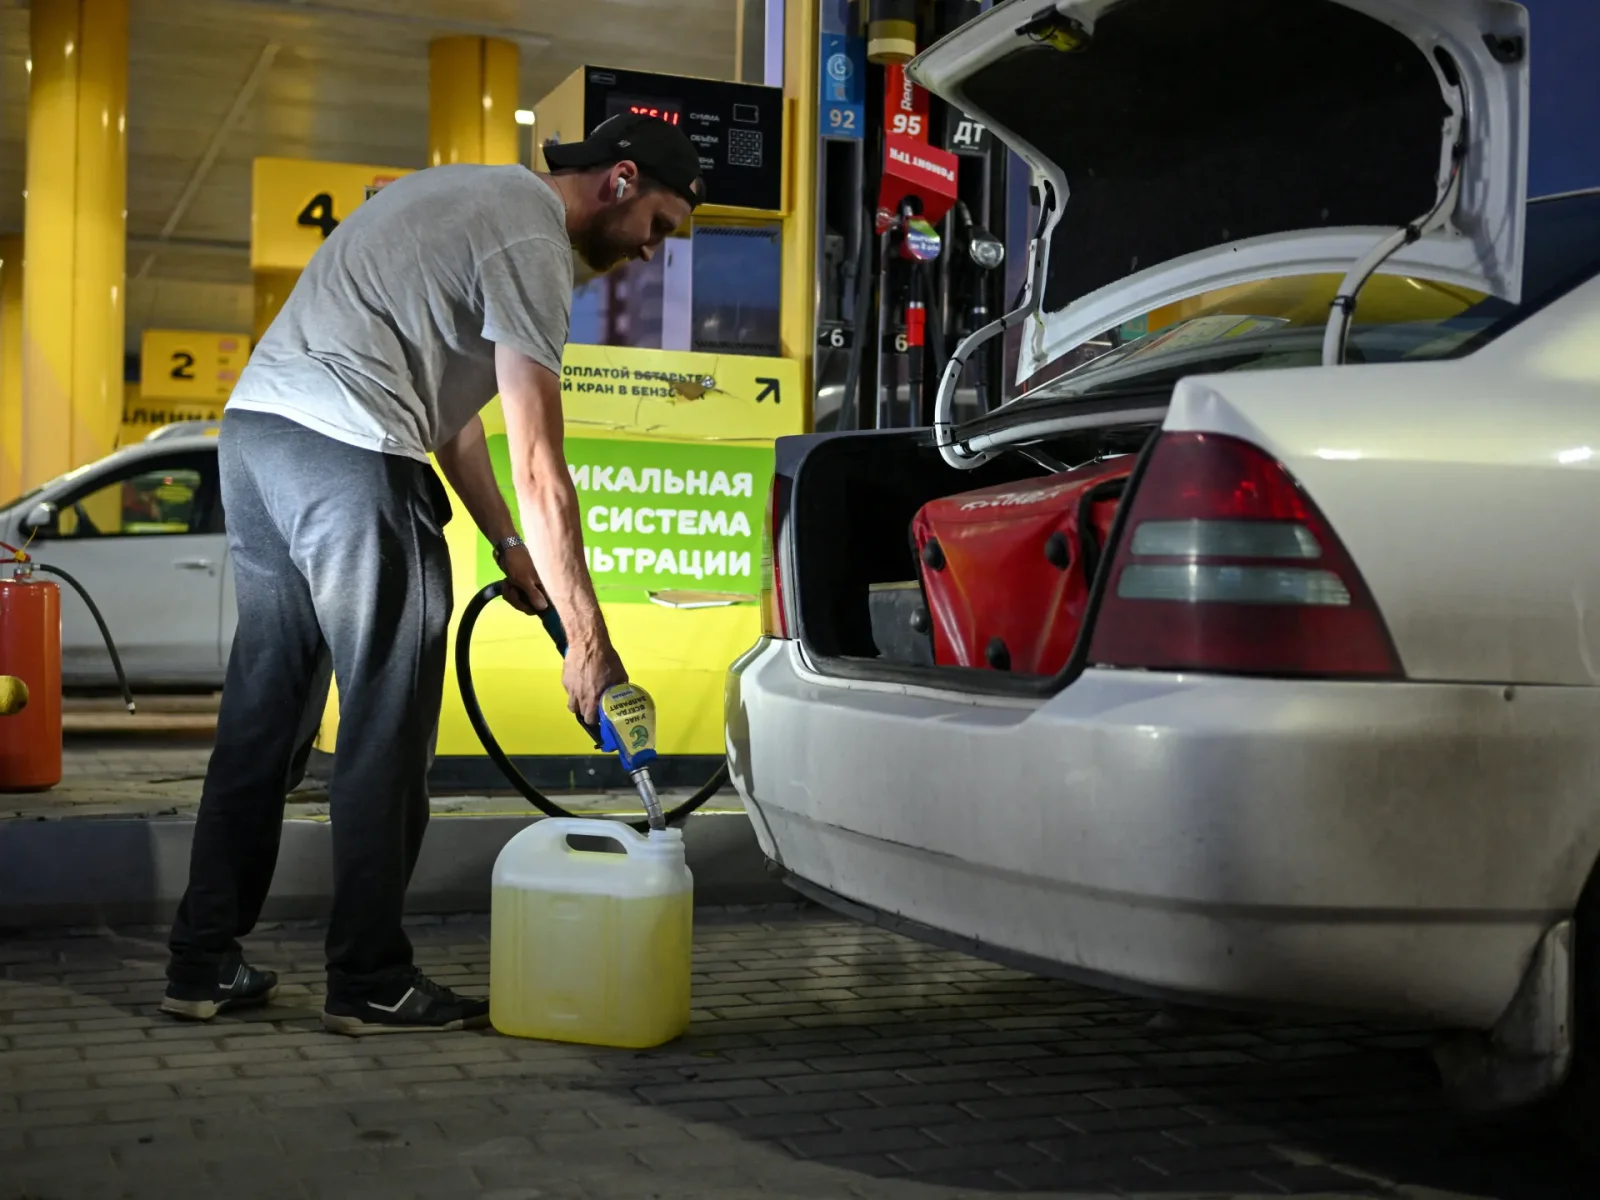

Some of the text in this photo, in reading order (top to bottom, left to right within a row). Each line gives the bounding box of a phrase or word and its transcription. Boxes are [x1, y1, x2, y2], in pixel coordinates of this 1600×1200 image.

[689, 112, 720, 122] СУММА
[830, 109, 855, 129] 92
[893, 114, 921, 135] 95
[953, 121, 985, 145] ДТ
[698, 156, 714, 165] ЕНА
[297, 191, 341, 239] 4
[830, 328, 844, 347] 6
[895, 334, 909, 352] 6
[170, 352, 195, 380] 2
[563, 365, 630, 380] ОПЛАТОЙ
[560, 379, 573, 392] Й
[577, 382, 614, 395] КРАН
[619, 386, 628, 395] В
[567, 463, 753, 498] ИКАЛЬНАЯ
[587, 505, 752, 537] СИСТЕМА
[585, 546, 751, 580] ЬТРАЦИИ
